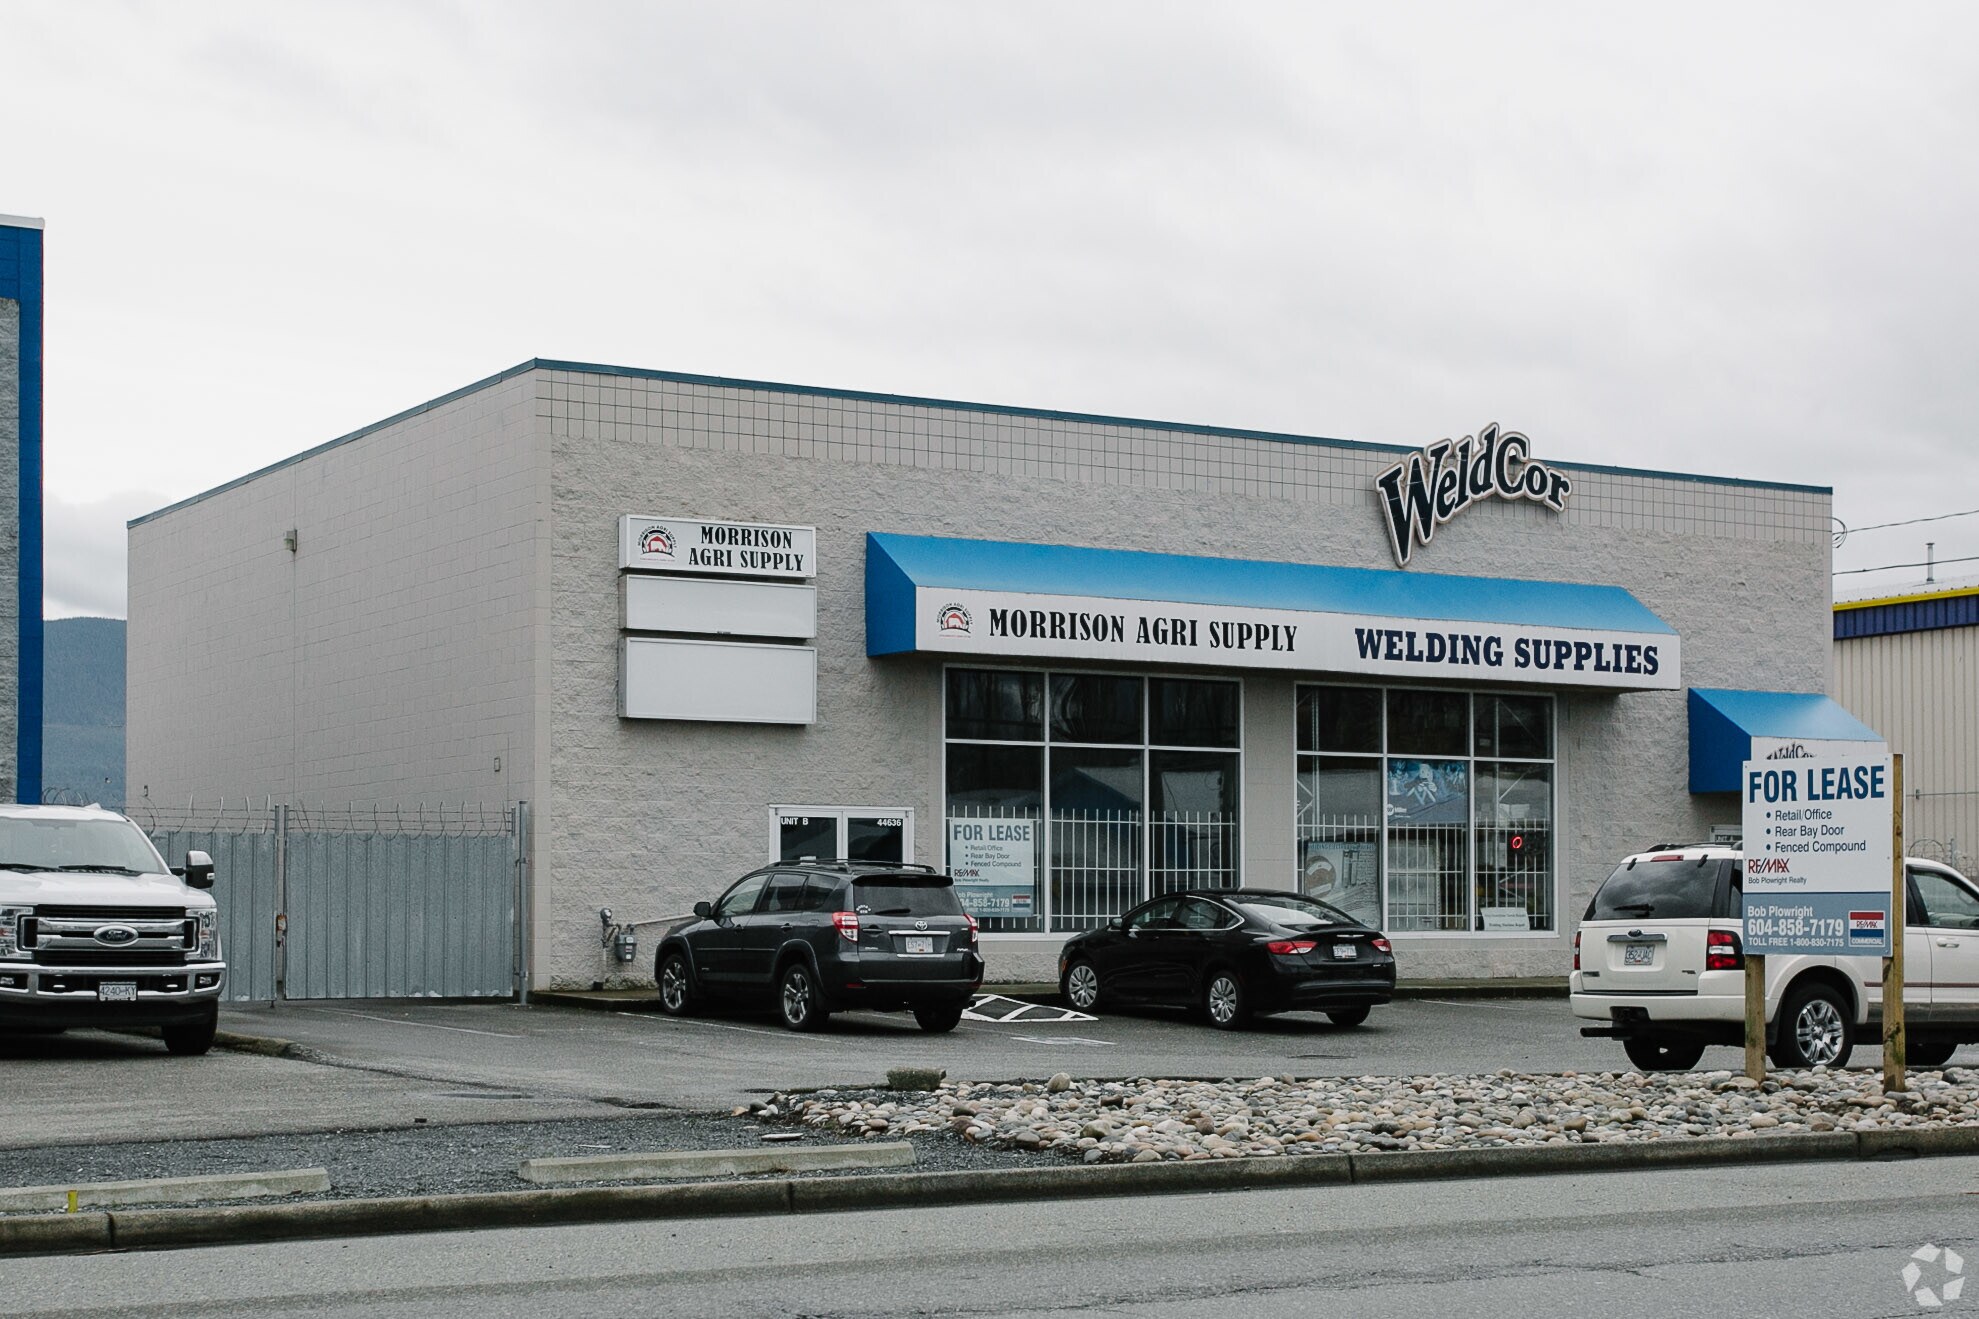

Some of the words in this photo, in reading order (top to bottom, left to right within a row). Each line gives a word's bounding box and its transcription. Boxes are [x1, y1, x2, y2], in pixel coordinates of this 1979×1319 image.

[1376, 423, 1571, 564] WeldCor
[700, 525, 793, 549] MORRISON
[688, 547, 732, 568] AGRI
[740, 550, 804, 572] SUPPLY
[989, 608, 1125, 643] MORRISON
[1136, 616, 1198, 647] AGRI
[1209, 621, 1298, 652] SUPPLY
[1354, 627, 1504, 667] WELDING
[1514, 637, 1659, 676] SUPPLIES
[1749, 769, 1797, 803] FOR
[1807, 765, 1885, 801] LEASE
[781, 817, 798, 825] UNIT
[802, 817, 808, 825] B
[877, 818, 901, 827] 44636
[953, 824, 983, 841] FOR
[988, 825, 1031, 841] LEASE
[1774, 826, 1797, 837] Rear
[1800, 826, 1818, 839] Bay
[1821, 824, 1845, 836] Door
[1774, 841, 1809, 853] Fenced
[1812, 840, 1866, 854] Compound
[1748, 858, 1790, 874] RE/MAX
[1789, 877, 1807, 885] Realty
[960, 899, 1009, 907] 4-858-7179
[1747, 906, 1766, 917] Bob
[1769, 906, 1813, 919] Plowright
[106, 929, 128, 939] Ford
[1748, 919, 1844, 936] 604-858-7179
[1748, 937, 1767, 946] TOLL
[1769, 937, 1788, 946] FREE
